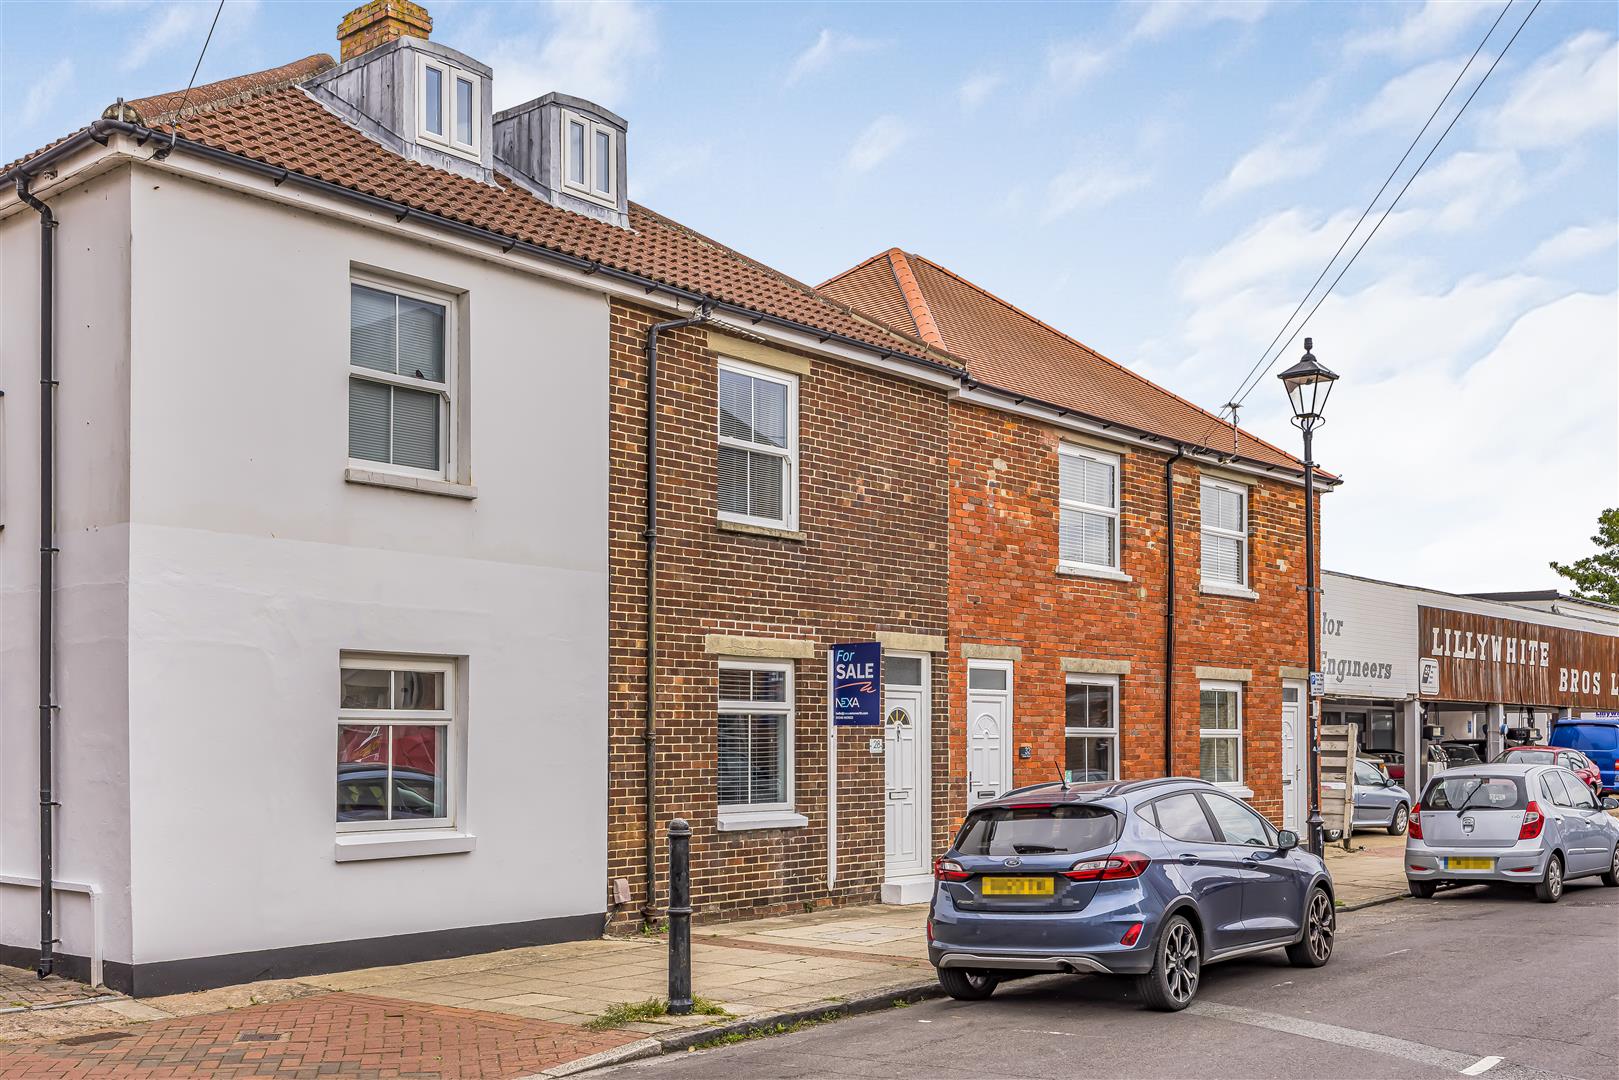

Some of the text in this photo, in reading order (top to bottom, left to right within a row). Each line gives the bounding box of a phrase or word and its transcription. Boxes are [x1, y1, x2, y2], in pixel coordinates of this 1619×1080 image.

[836, 649, 855, 662] For
[1431, 627, 1550, 668] LILLYWHITE
[836, 663, 874, 680] SALE
[1558, 667, 1601, 695] BROS
[835, 697, 860, 708] NEXA
